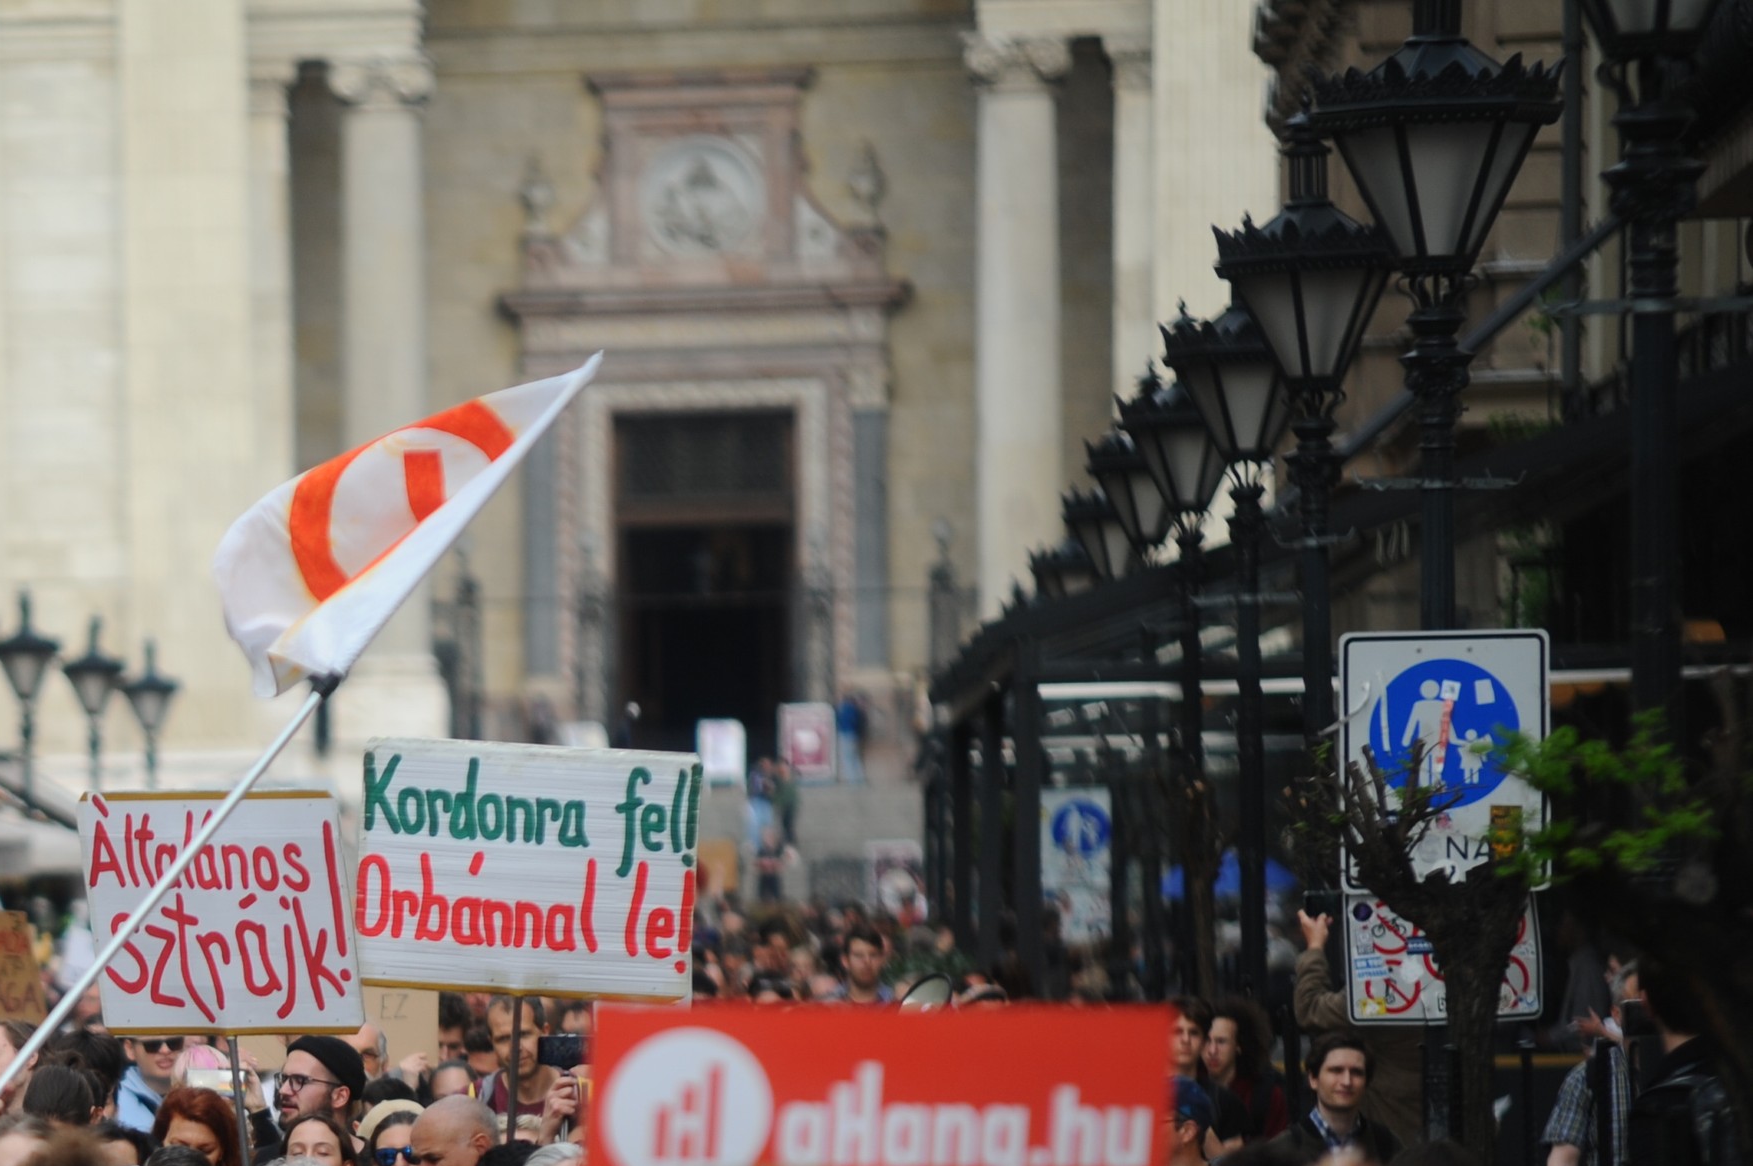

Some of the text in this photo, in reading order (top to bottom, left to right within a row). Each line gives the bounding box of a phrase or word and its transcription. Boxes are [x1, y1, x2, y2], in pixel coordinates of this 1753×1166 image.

[363, 750, 703, 878] Kordonra fel!
[354, 851, 698, 974] Orbánnal le!
[380, 993, 409, 1020] EZ
